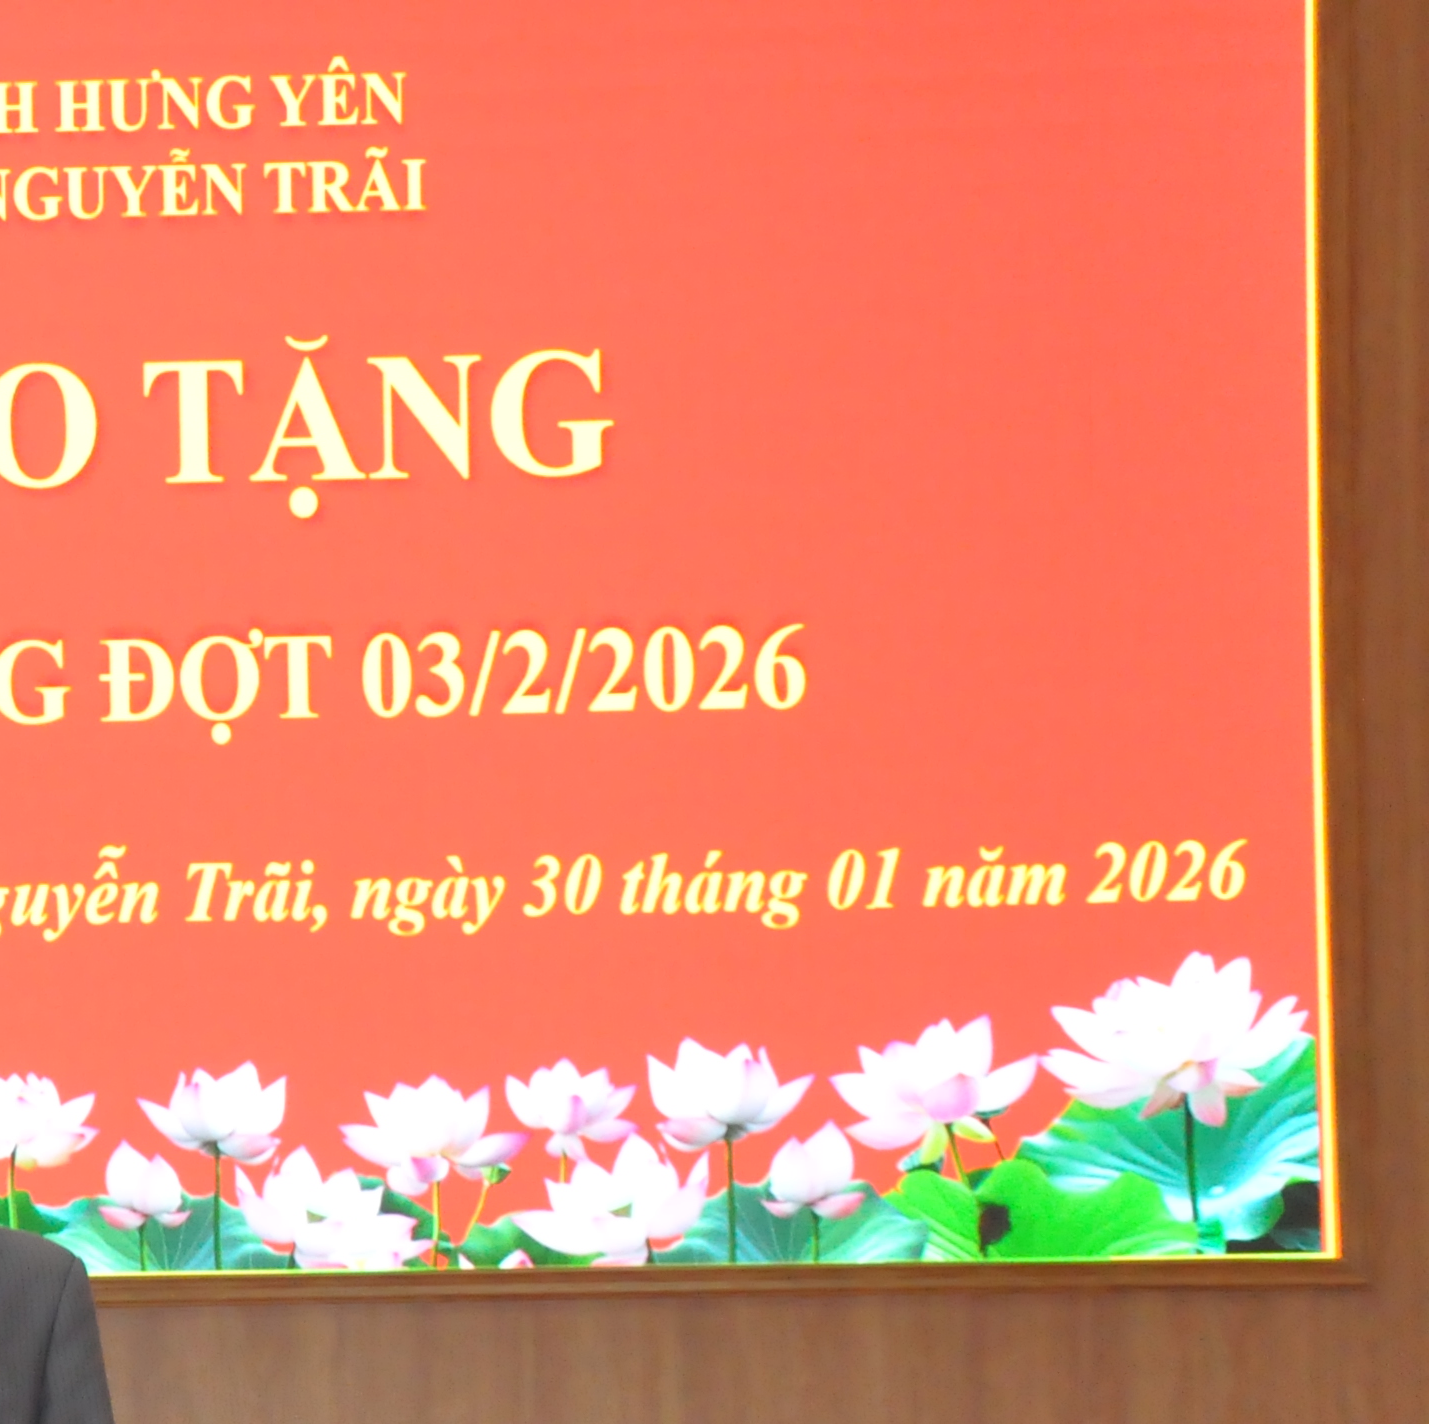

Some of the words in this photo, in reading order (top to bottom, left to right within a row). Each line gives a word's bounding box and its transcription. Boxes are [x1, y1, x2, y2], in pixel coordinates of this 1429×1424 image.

[55, 69, 255, 133] HƯNG
[270, 56, 406, 126] YÊN
[263, 146, 426, 213] TRÃI
[143, 335, 614, 518] TẶNG
[99, 628, 332, 745] ĐỢT
[362, 624, 806, 718] 03/2/2026
[185, 859, 328, 932] Trãi,
[350, 855, 506, 936] ngày
[523, 854, 602, 917] 30
[620, 850, 808, 929] tháng
[827, 847, 900, 910] 01
[922, 846, 1067, 908] năm
[1086, 839, 1247, 904] 2026
